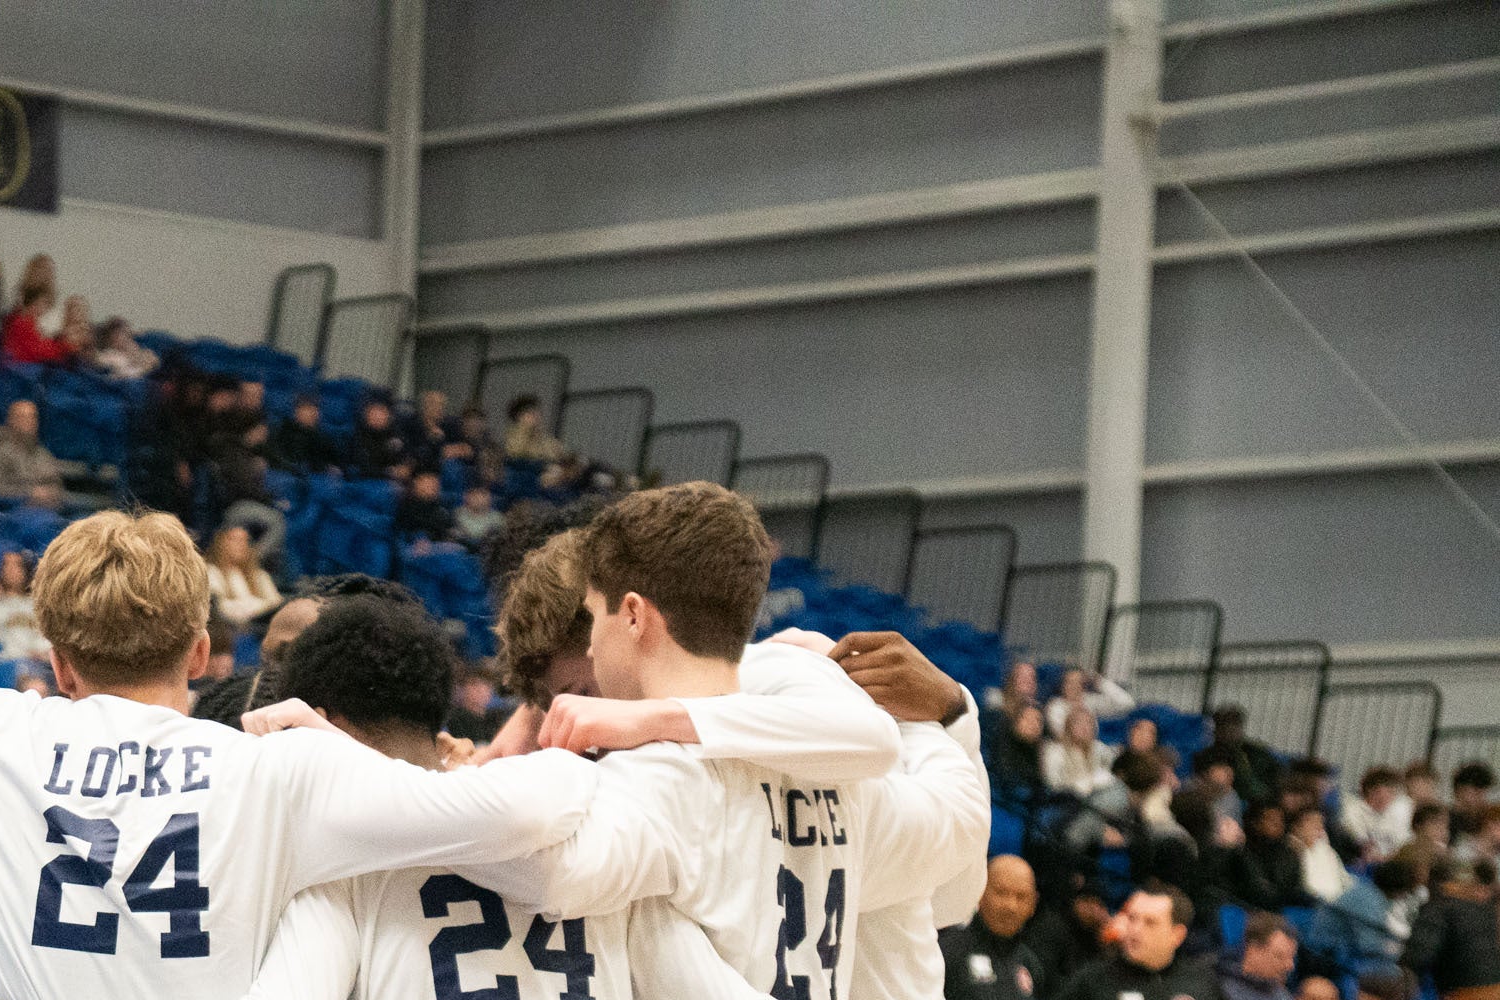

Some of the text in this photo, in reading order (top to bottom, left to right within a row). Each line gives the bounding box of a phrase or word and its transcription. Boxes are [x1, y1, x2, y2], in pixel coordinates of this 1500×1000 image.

[43, 740, 213, 799] LOCKE
[760, 782, 848, 848] LCE
[30, 804, 211, 959] 24
